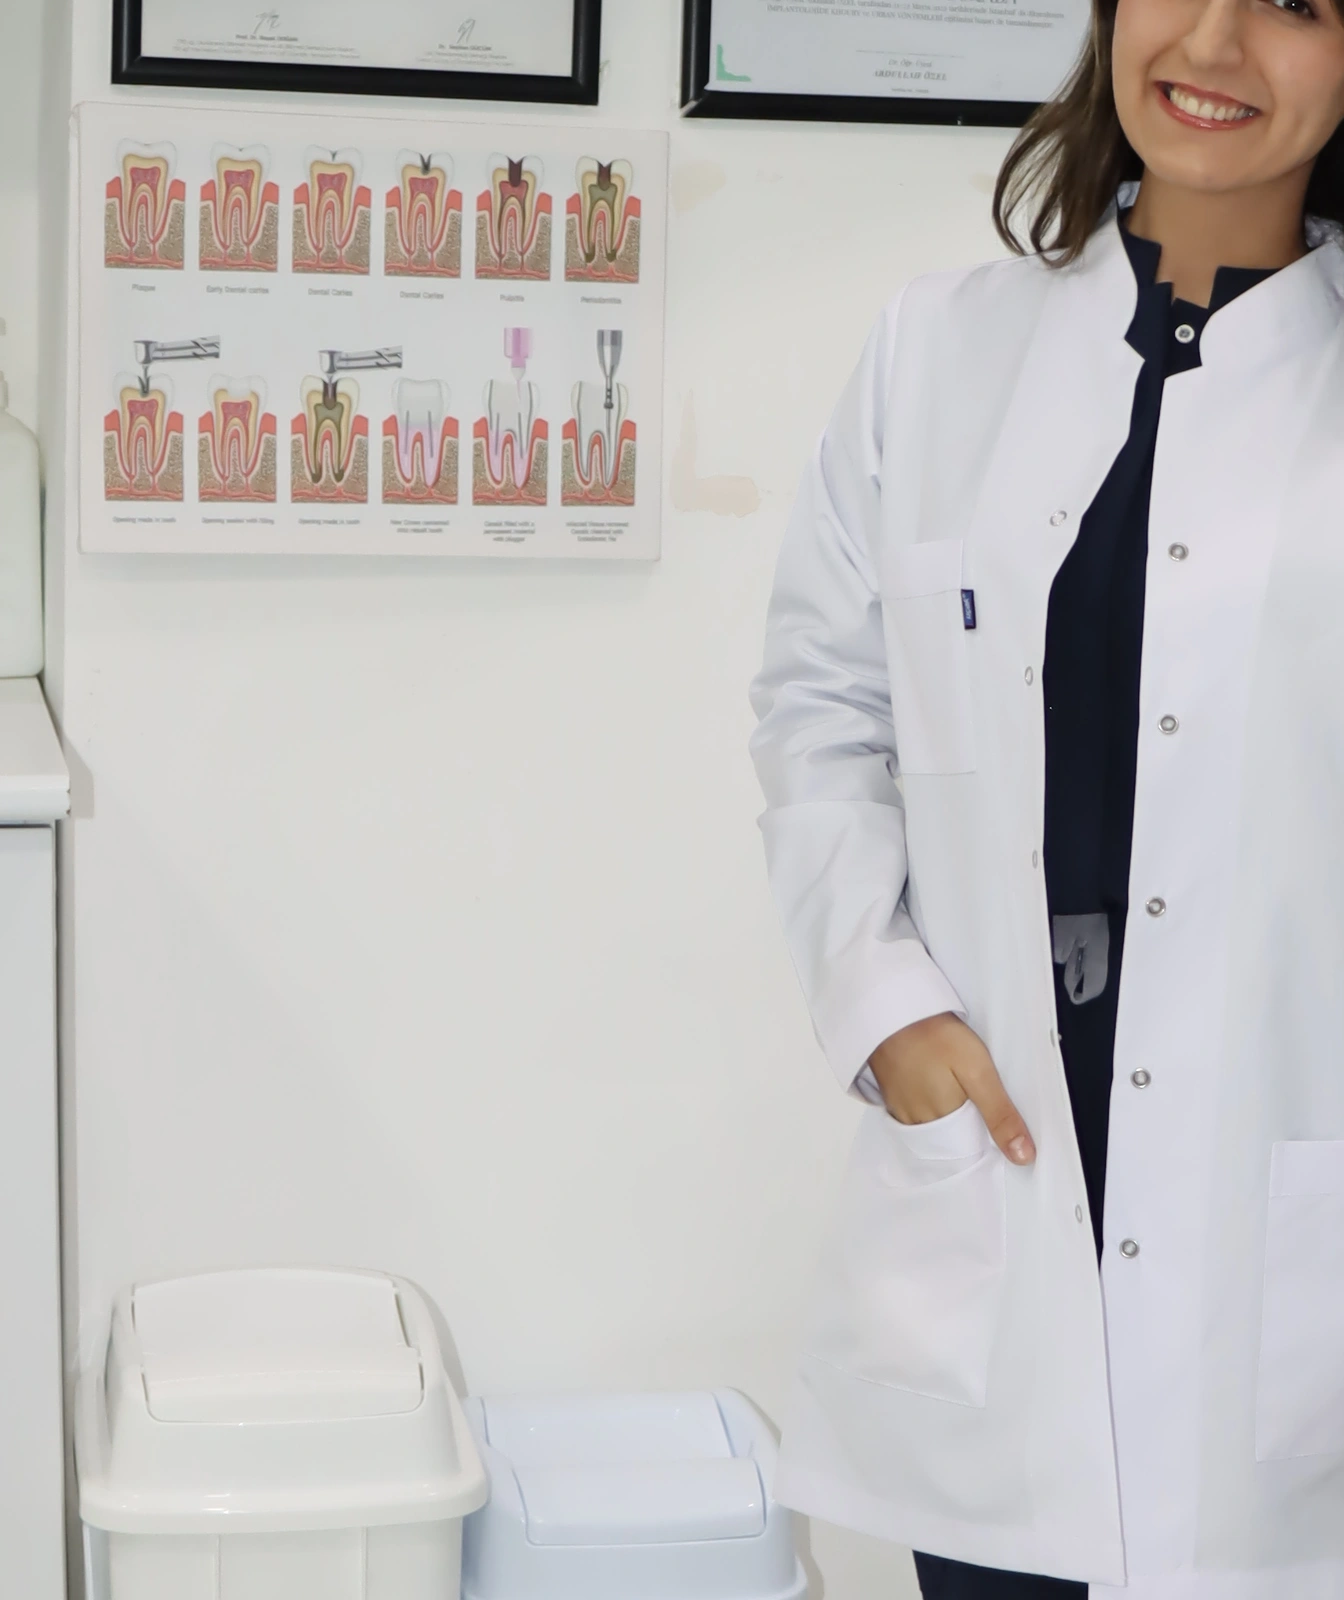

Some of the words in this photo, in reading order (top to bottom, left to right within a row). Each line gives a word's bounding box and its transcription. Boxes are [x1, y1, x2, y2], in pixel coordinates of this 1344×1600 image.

[131, 283, 157, 293] Plaque
[207, 284, 223, 296] Early
[225, 285, 247, 294] Dental
[308, 288, 330, 297] Dental
[332, 289, 353, 298] Caries
[400, 290, 421, 299] Dental
[423, 291, 444, 301] Caries
